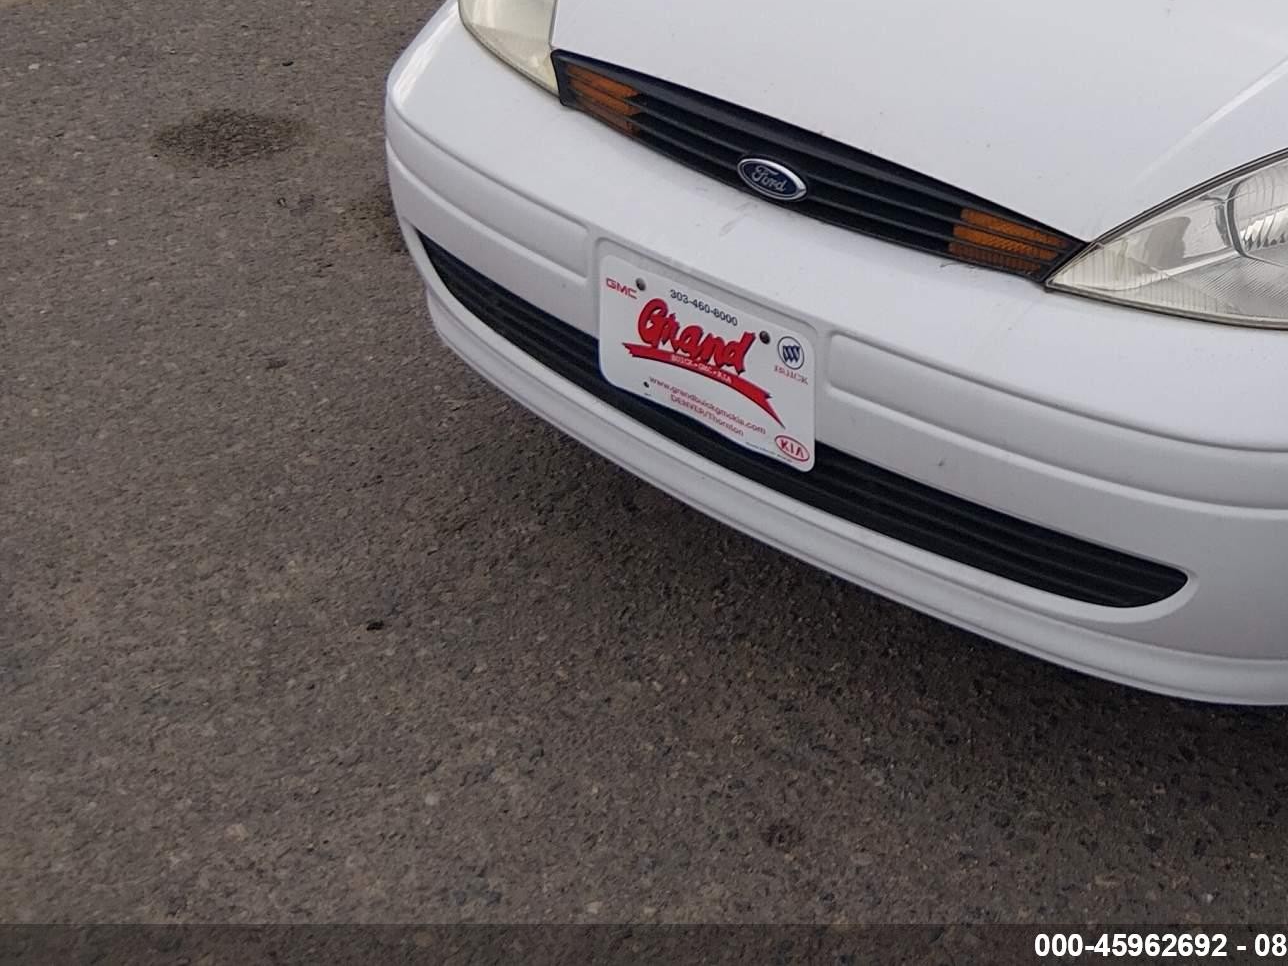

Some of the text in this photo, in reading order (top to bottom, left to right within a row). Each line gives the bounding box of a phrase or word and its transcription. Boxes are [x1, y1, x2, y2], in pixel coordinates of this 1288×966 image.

[751, 165, 789, 193] Ford
[606, 277, 637, 300] GMC
[638, 298, 756, 375] Grand
[781, 439, 804, 459] KIA
